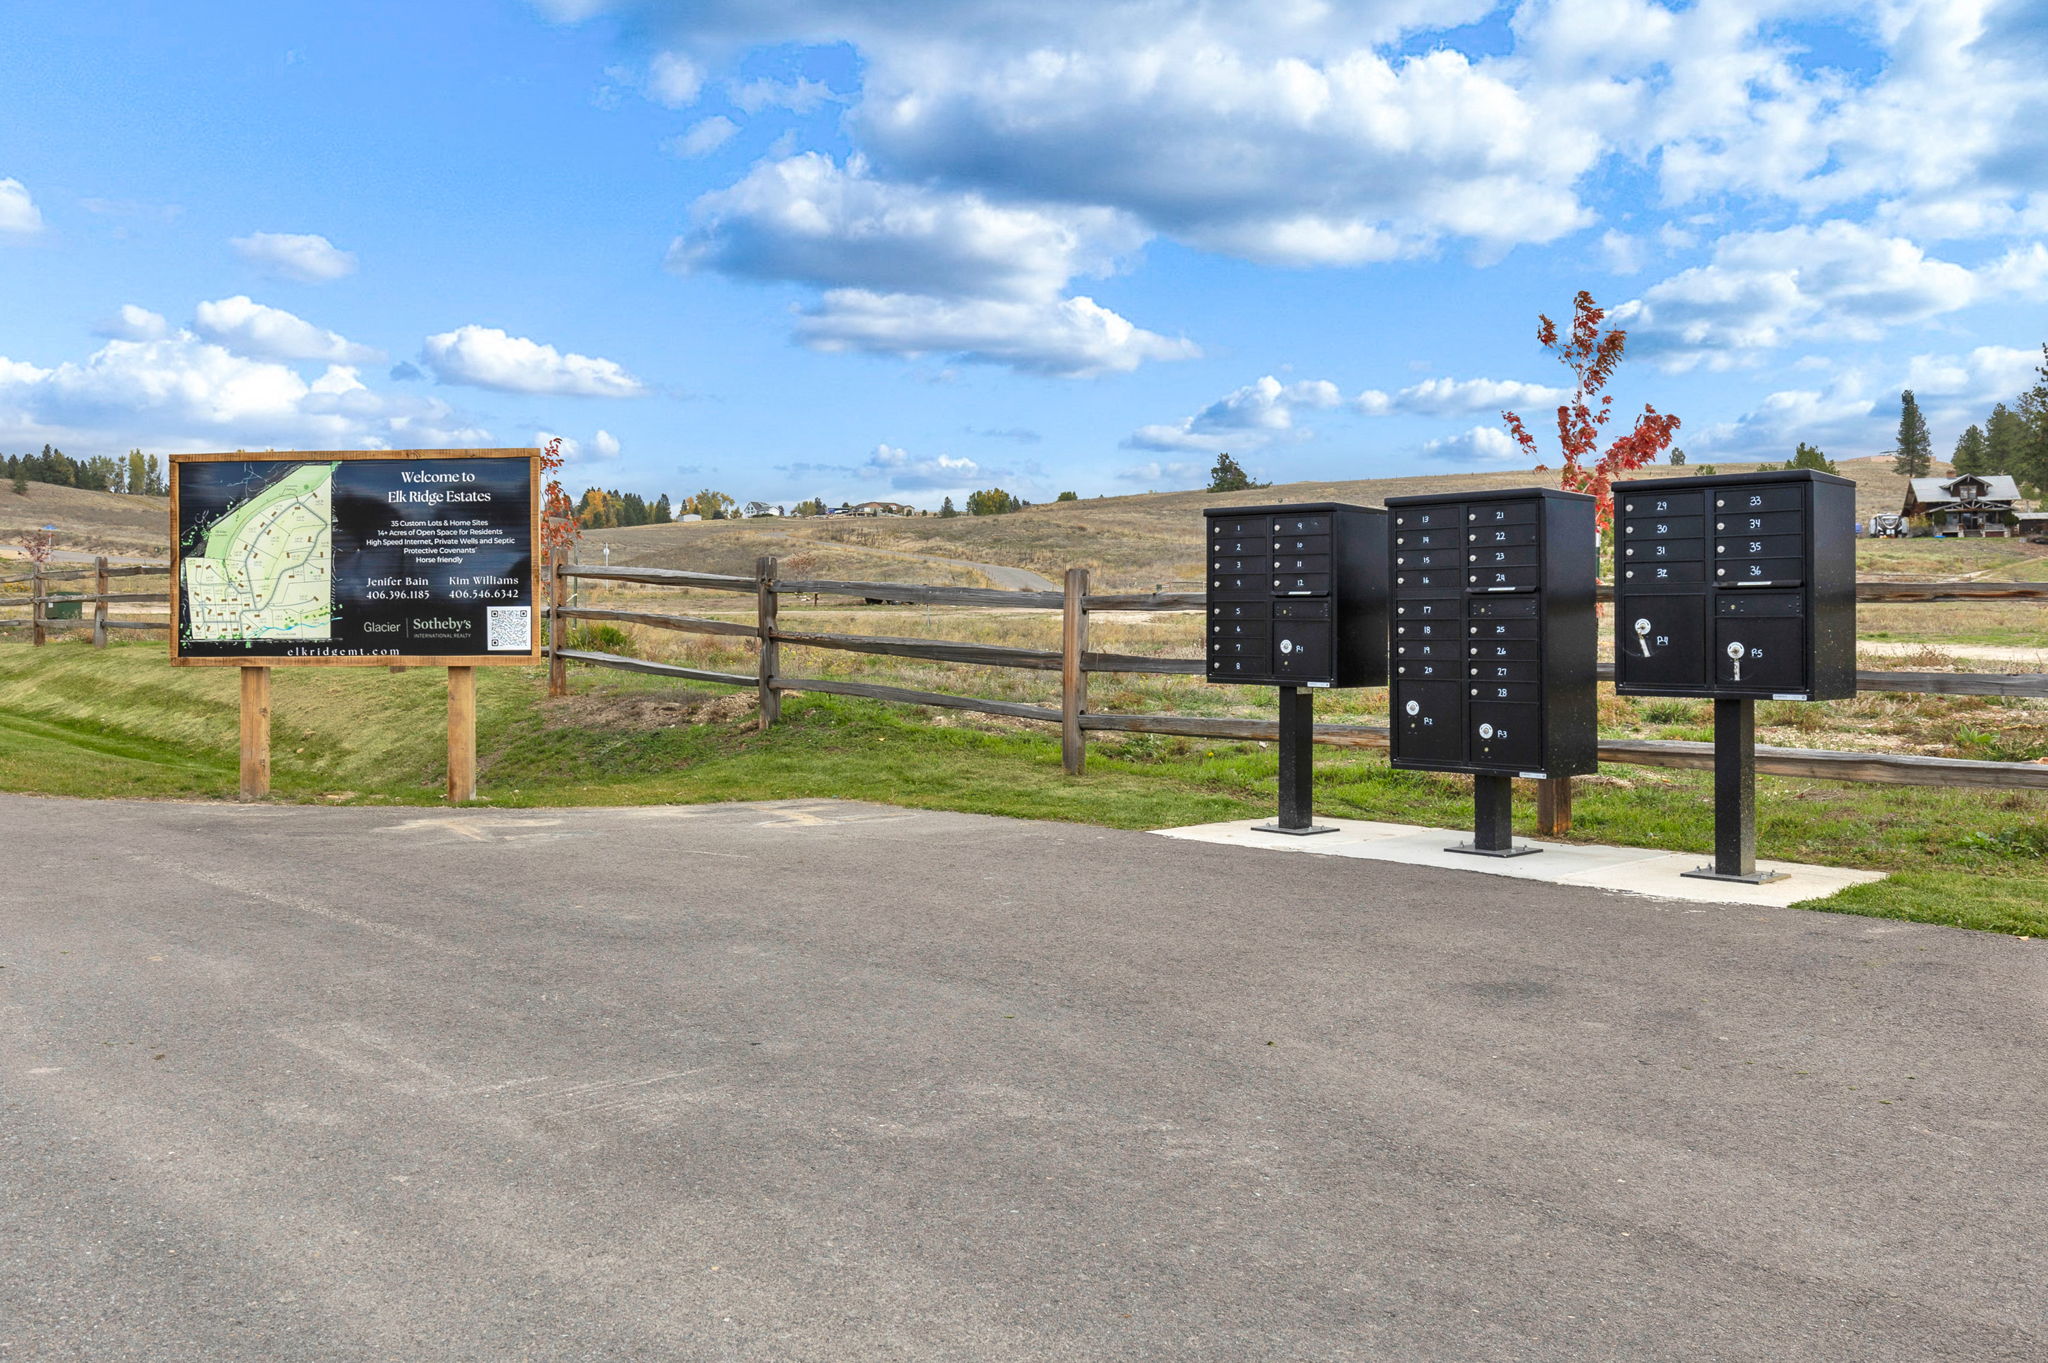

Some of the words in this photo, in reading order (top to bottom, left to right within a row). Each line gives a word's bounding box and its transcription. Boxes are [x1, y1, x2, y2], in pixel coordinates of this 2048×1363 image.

[402, 471, 459, 482] Welcome
[462, 473, 475, 482] to
[389, 491, 407, 502] Elk
[410, 490, 443, 505] Ridge
[447, 491, 491, 502] Estates
[1749, 496, 1762, 506] 33
[1656, 502, 1668, 510] 29
[1749, 519, 1761, 528] 34
[1656, 525, 1668, 533] 30
[1495, 532, 1506, 540] 22
[1656, 547, 1666, 555] 31
[1749, 542, 1762, 552] 35
[1656, 569, 1668, 577] 32
[1749, 566, 1762, 575] 36
[367, 577, 402, 587] Jenifer
[450, 577, 469, 585] Kim
[473, 576, 518, 584] Williams
[366, 590, 429, 599] 406.396.1185
[449, 590, 518, 599] 406.546.6342
[364, 622, 400, 632] Glacier
[414, 617, 471, 632] Sotheby's
[1423, 626, 1431, 634] 18
[287, 647, 400, 656] elkridgemt.com
[1497, 689, 1508, 697] 28
